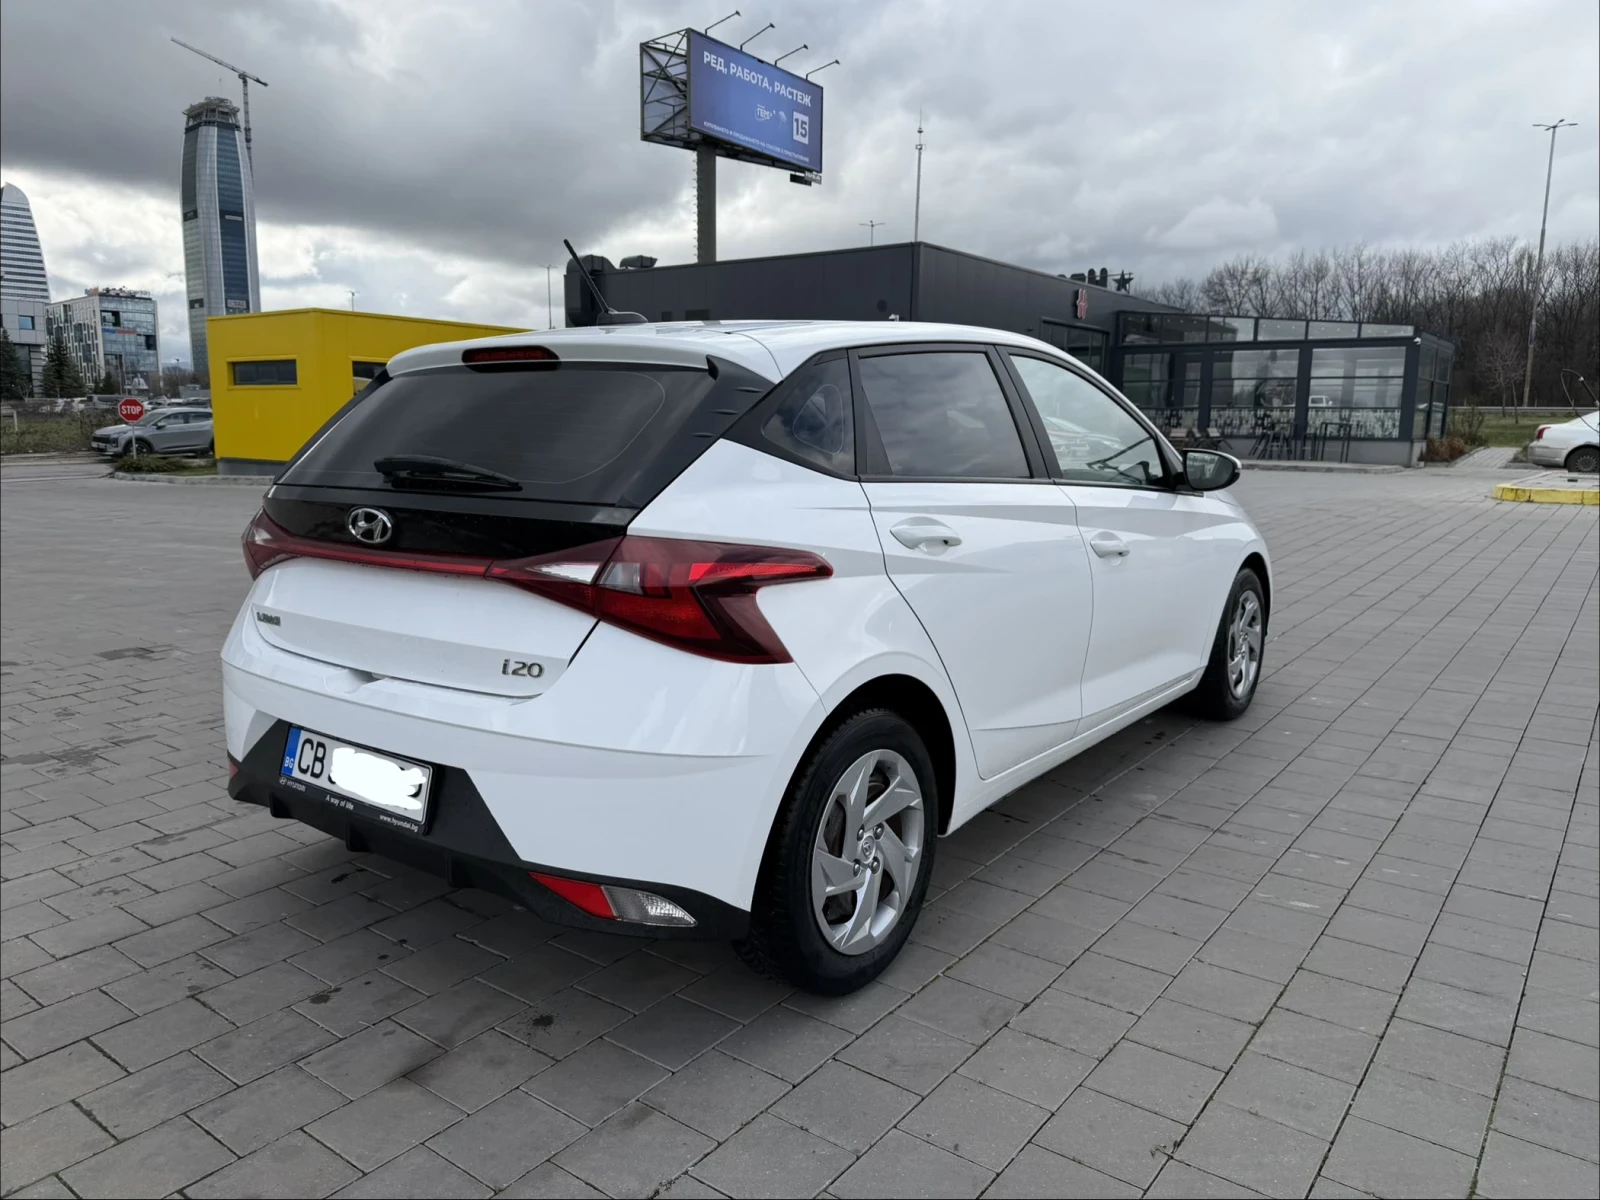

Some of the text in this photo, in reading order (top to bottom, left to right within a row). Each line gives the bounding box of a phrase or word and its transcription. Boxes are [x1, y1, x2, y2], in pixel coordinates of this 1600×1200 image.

[703, 51, 812, 107] РЕД, РАБОТА, РАСТЕЖ
[794, 117, 808, 139] 15
[121, 405, 141, 415] STOP
[501, 658, 545, 679] i20
[284, 756, 295, 769] BG
[297, 737, 327, 779] CB
[330, 798, 339, 807] way
[345, 801, 354, 810] life
[379, 814, 419, 832] www.hyundai.bg
